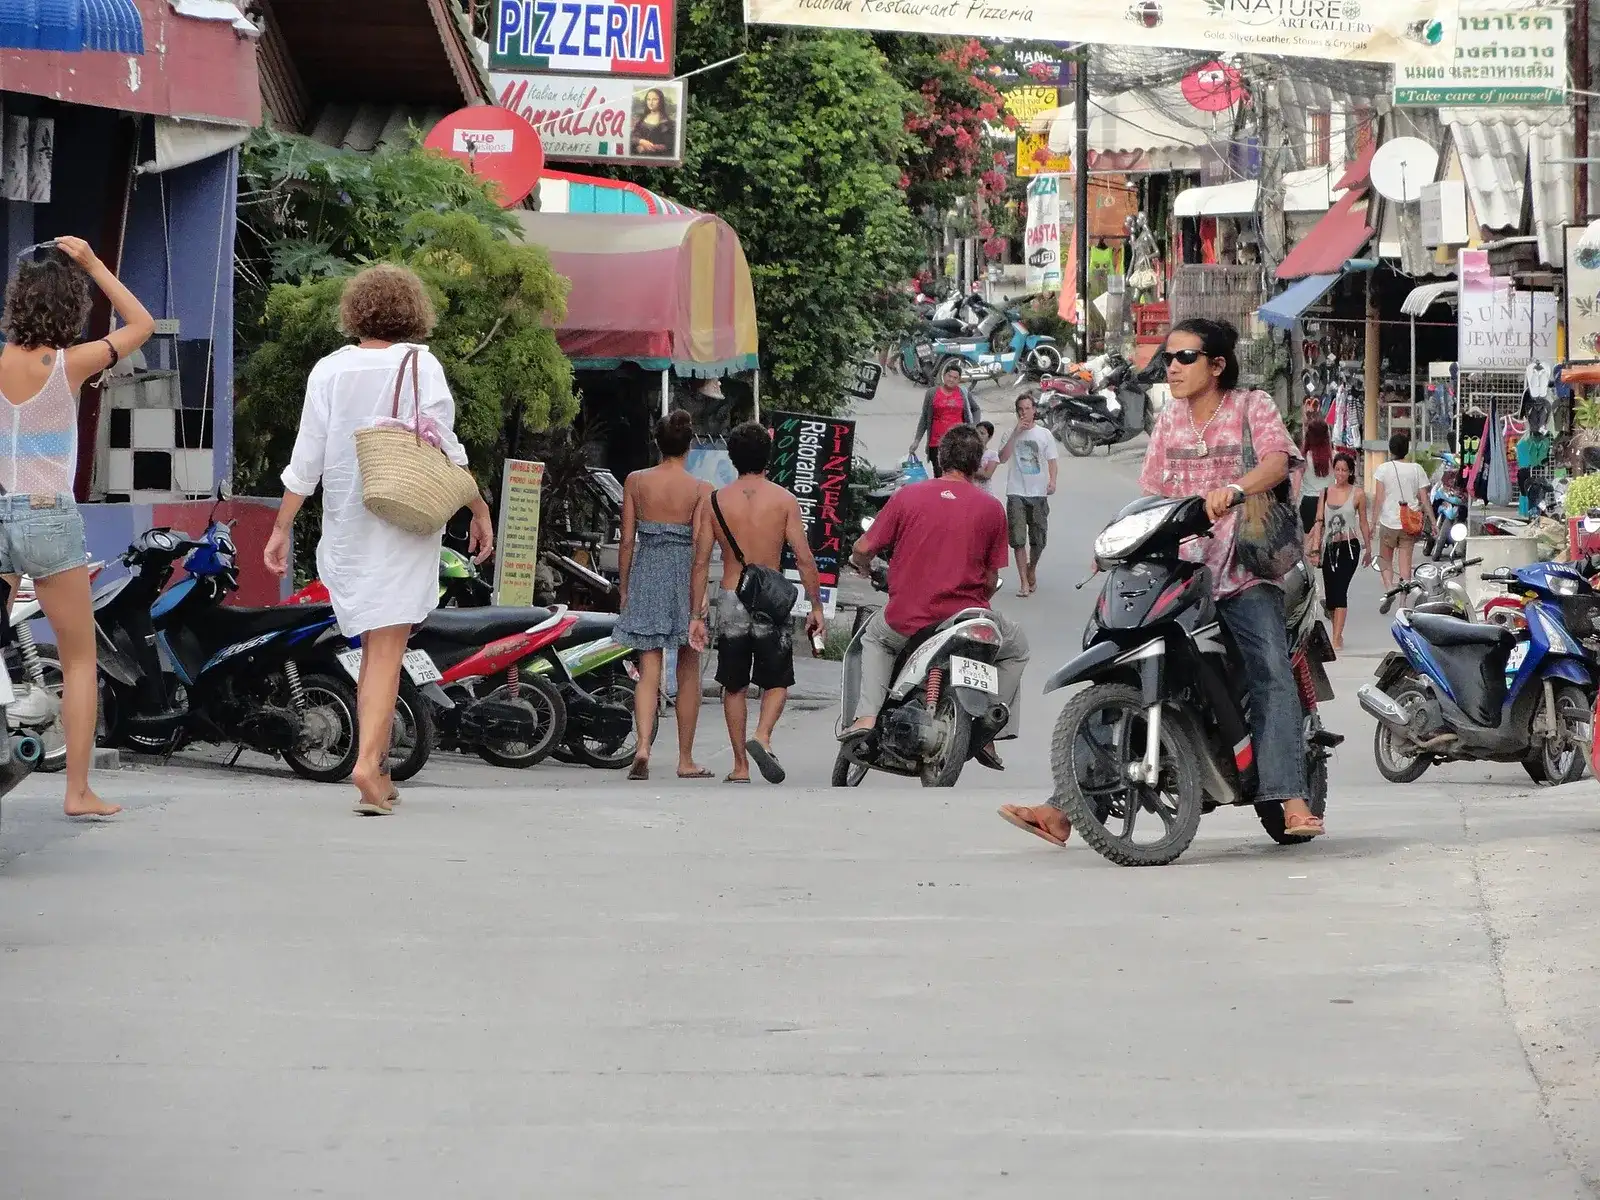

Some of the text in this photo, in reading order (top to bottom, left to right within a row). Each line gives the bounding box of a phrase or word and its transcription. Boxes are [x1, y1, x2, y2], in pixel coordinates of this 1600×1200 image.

[861, 0, 959, 18] Restaurant
[966, 0, 1033, 21] Pizzeria
[497, 0, 664, 61] PIZZERIA
[1279, 18, 1373, 33] ART GALLERY
[1256, 35, 1290, 45] Leather,
[1334, 39, 1368, 50] Crystals
[527, 84, 586, 107] Italian chef
[1446, 93, 1476, 101] care
[1480, 89, 1496, 104] of
[461, 131, 495, 143] true
[1027, 223, 1057, 246] PASTA
[1463, 305, 1555, 328] SUNNY
[1465, 331, 1552, 348] JEWELRY
[794, 420, 827, 493] Ristorante
[817, 423, 850, 551] PIZZERIA
[418, 670, 436, 681] 785
[963, 676, 988, 689] 679
